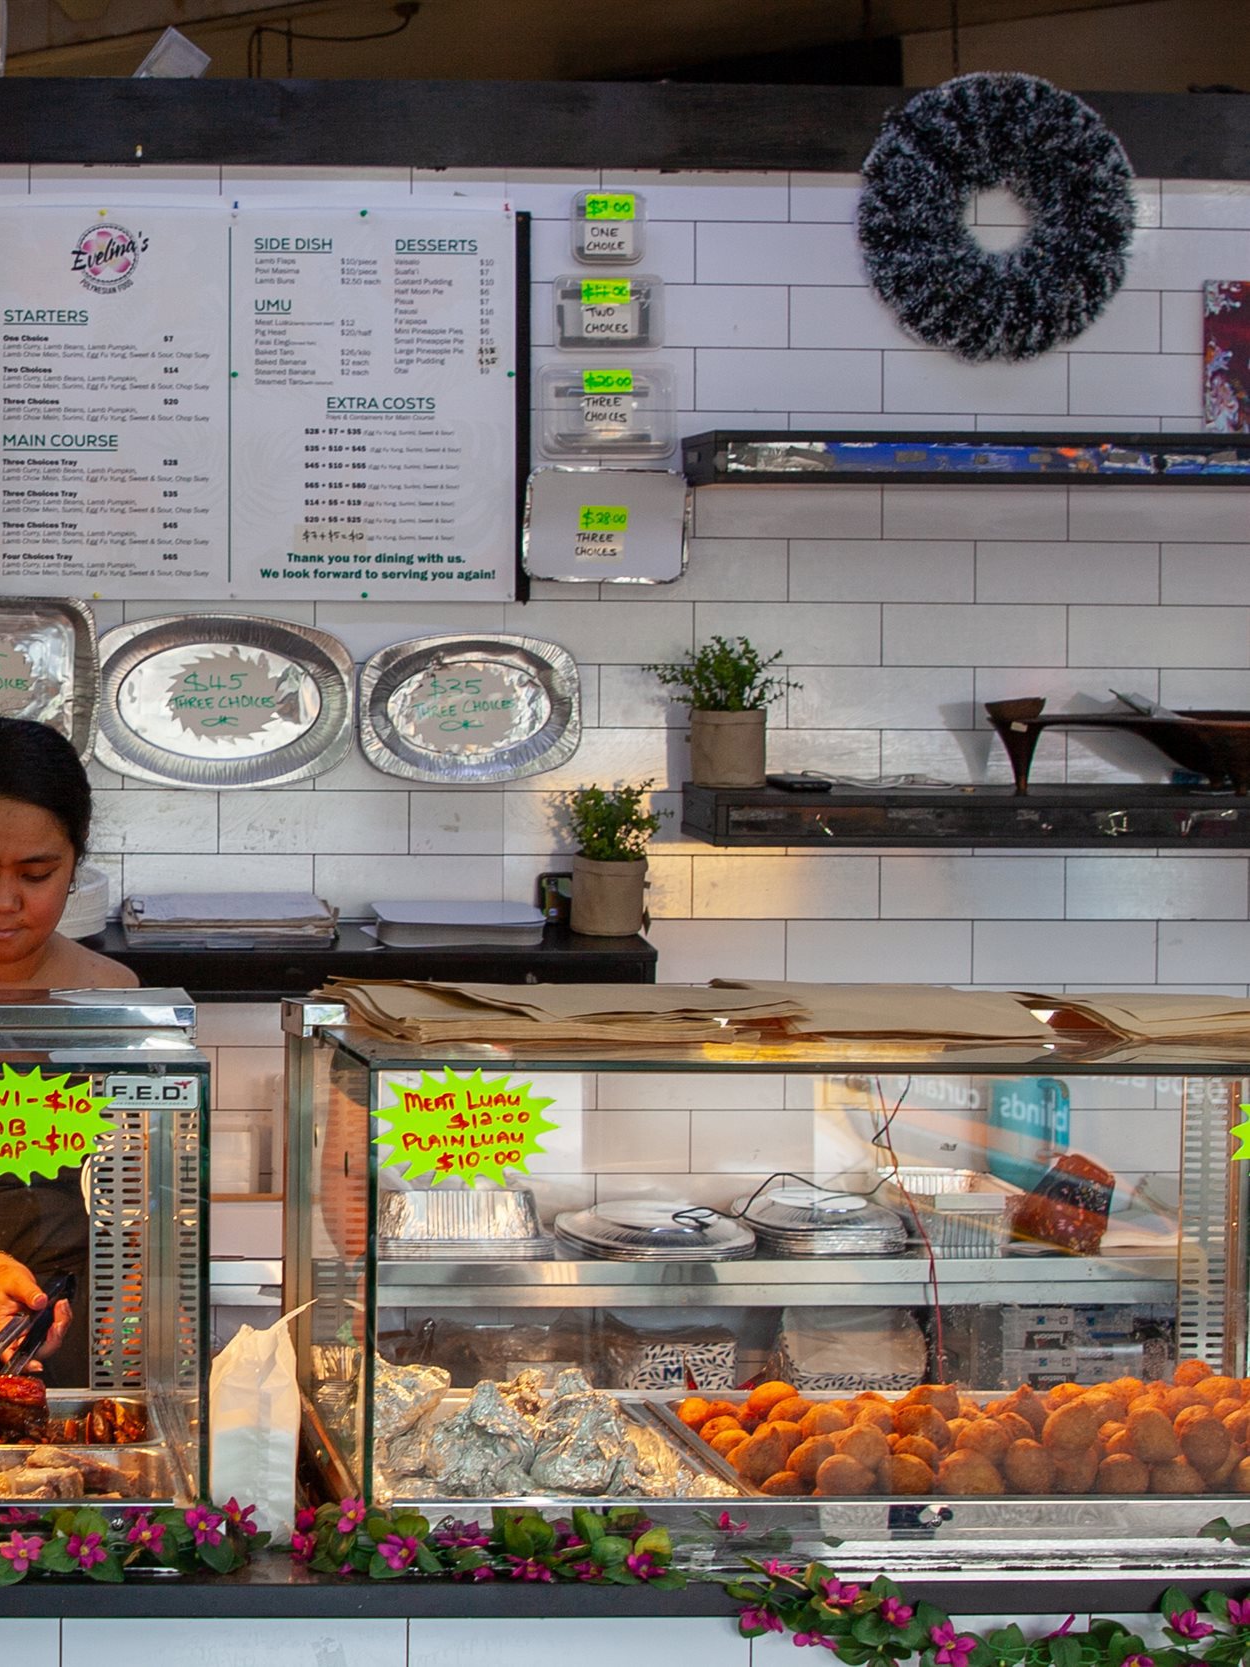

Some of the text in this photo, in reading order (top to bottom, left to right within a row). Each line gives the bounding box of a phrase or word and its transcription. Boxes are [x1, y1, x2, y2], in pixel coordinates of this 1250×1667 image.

[591, 227, 619, 237] ONE
[254, 238, 332, 250] SIDE DISH
[396, 239, 478, 251] DESSERTS
[586, 241, 625, 251] CHOICE
[71, 231, 149, 271] Evelina's
[423, 278, 453, 287] Pudding
[480, 278, 494, 286] $10
[254, 300, 292, 311] UMU
[3, 309, 89, 323] STARTERS
[586, 307, 615, 316] TWO
[255, 329, 268, 337] Pig
[410, 328, 446, 336] Pineapple
[585, 324, 628, 333] CHOICES
[416, 338, 453, 346] Pineapple
[327, 397, 435, 410] EXTRA COSTS
[585, 397, 621, 407] THREE
[585, 412, 627, 423] CHOICES
[3, 435, 118, 447] MAIN COURSE
[61, 459, 77, 467] Tray
[61, 490, 77, 498] Tray
[163, 490, 178, 498] $35
[61, 522, 77, 530] Tray
[577, 533, 613, 542] THREE
[56, 553, 72, 561] Tray
[163, 553, 178, 561] $65
[575, 548, 617, 557] CHOICES
[287, 553, 465, 565] Thank you for dining with us.
[260, 569, 496, 582] We look forward to serving you again!
[182, 672, 248, 691] $45
[171, 696, 276, 709] THREE CHOICES
[414, 699, 516, 718] THREE CHOICES
[112, 1086, 188, 1100] F.E.D.
[404, 1091, 521, 1113] MEAT LUAU
[402, 1132, 524, 1151] PLAIN LUAU
[664, 1367, 682, 1380] M
